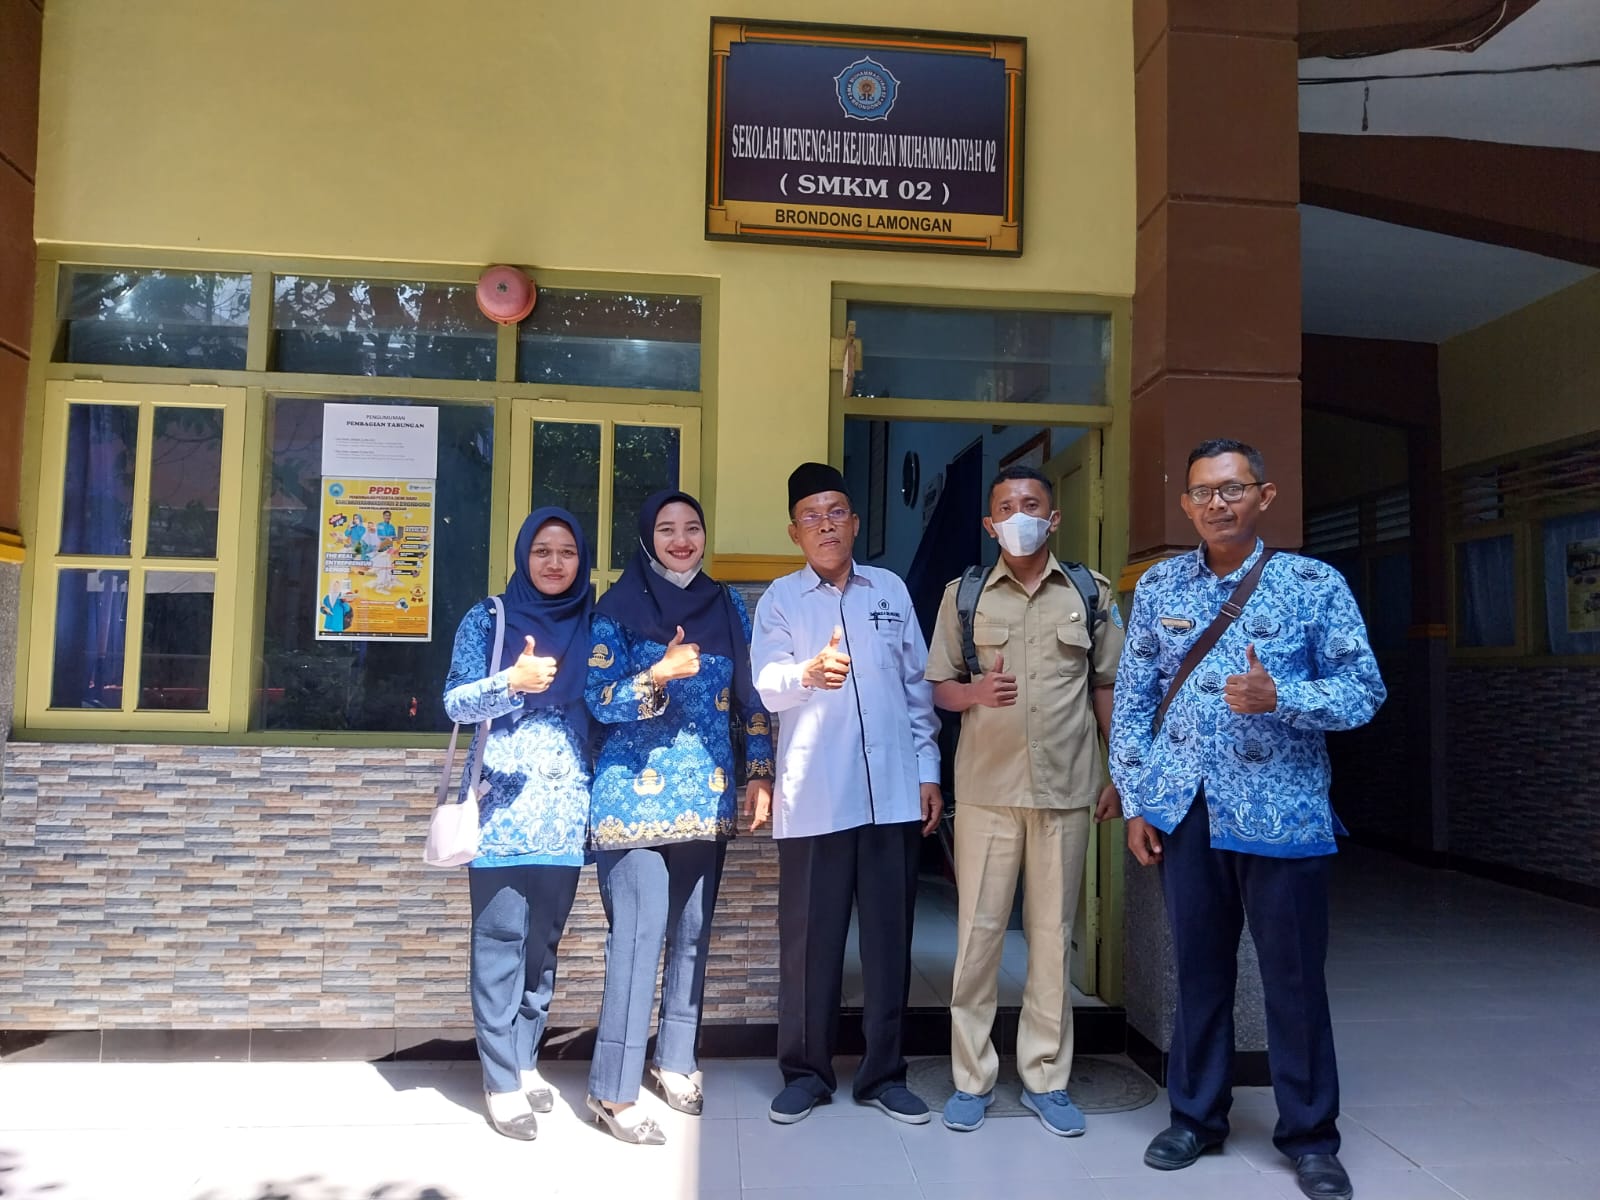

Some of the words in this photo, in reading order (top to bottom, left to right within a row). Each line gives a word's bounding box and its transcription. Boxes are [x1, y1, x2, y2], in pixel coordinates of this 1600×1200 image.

[731, 124, 780, 159] SEKOLAH
[782, 127, 841, 163] MENENGAH
[843, 131, 897, 167] KEJURUAN
[898, 135, 982, 172] MUHAMMADIYAH
[984, 139, 997, 173] 02
[797, 174, 889, 199] SMKM
[898, 180, 932, 201] 02
[775, 208, 862, 228] BRONDONG
[867, 214, 952, 233] LAMONGAN
[346, 420, 386, 428] PEMBAGIAN
[368, 486, 401, 495] PPDB
